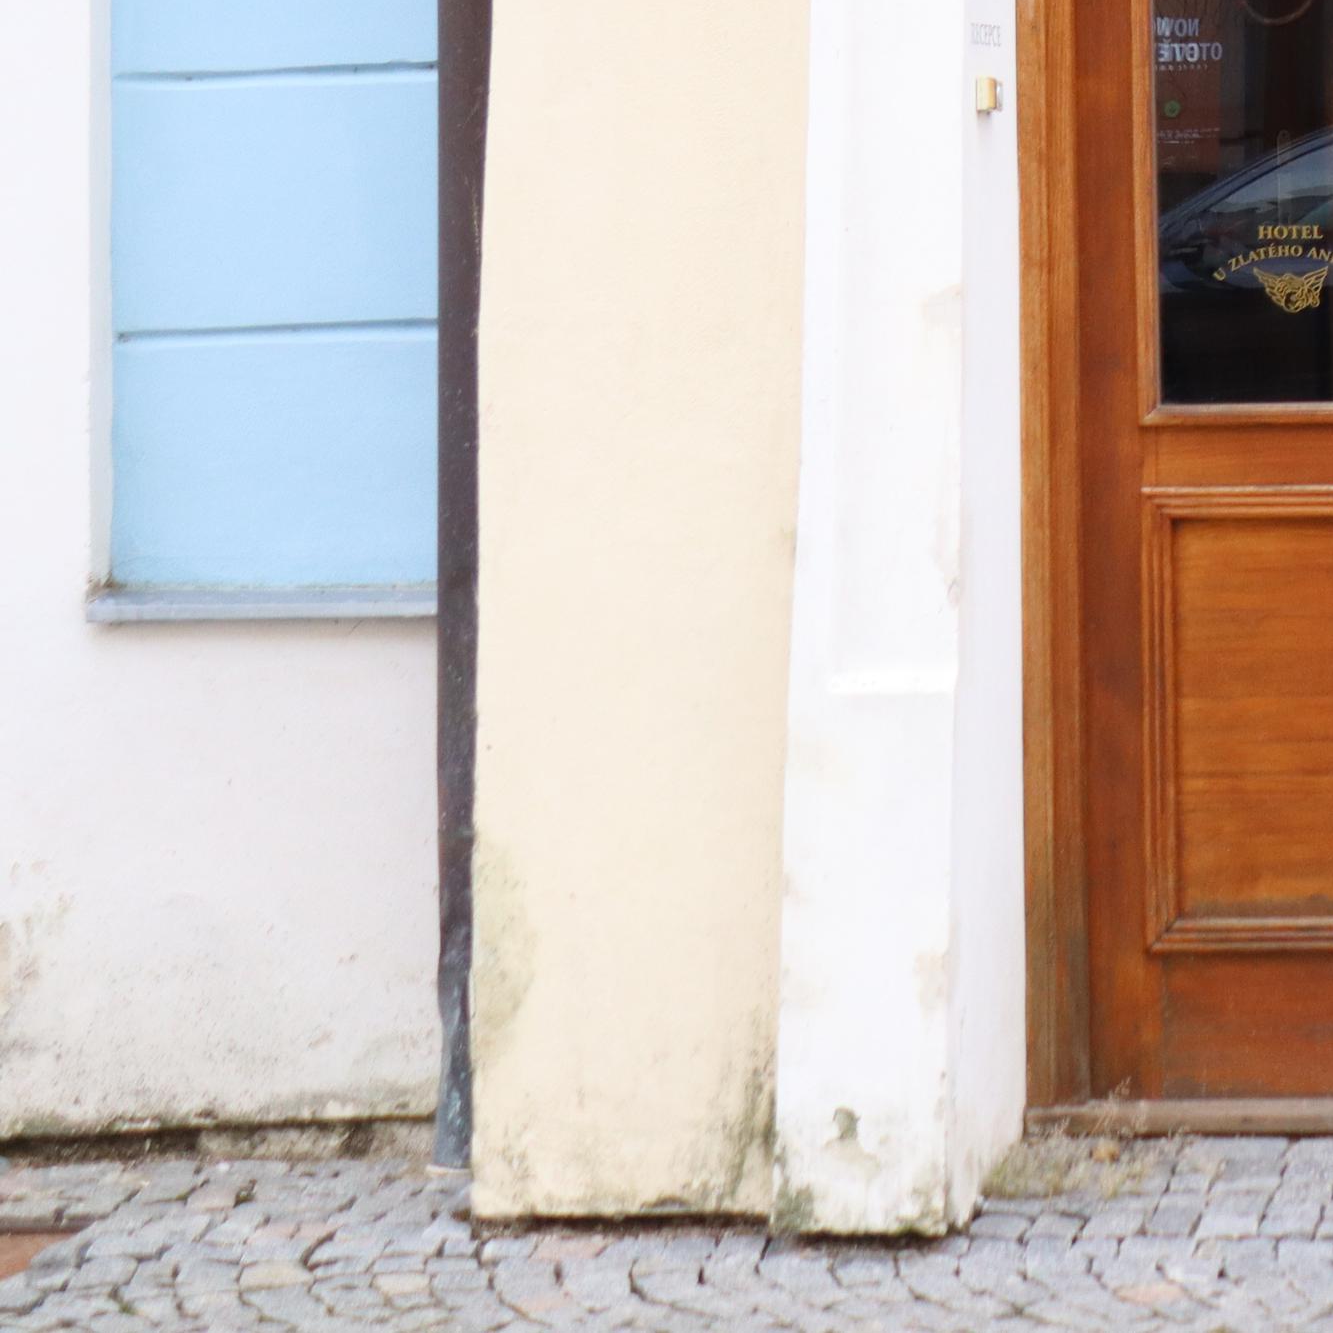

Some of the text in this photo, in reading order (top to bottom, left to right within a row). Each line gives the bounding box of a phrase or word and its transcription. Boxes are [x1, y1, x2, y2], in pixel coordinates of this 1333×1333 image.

[1258, 224, 1324, 240] HOTEL
[1212, 267, 1227, 281] U
[1227, 242, 1303, 273] ZLATÉHO
